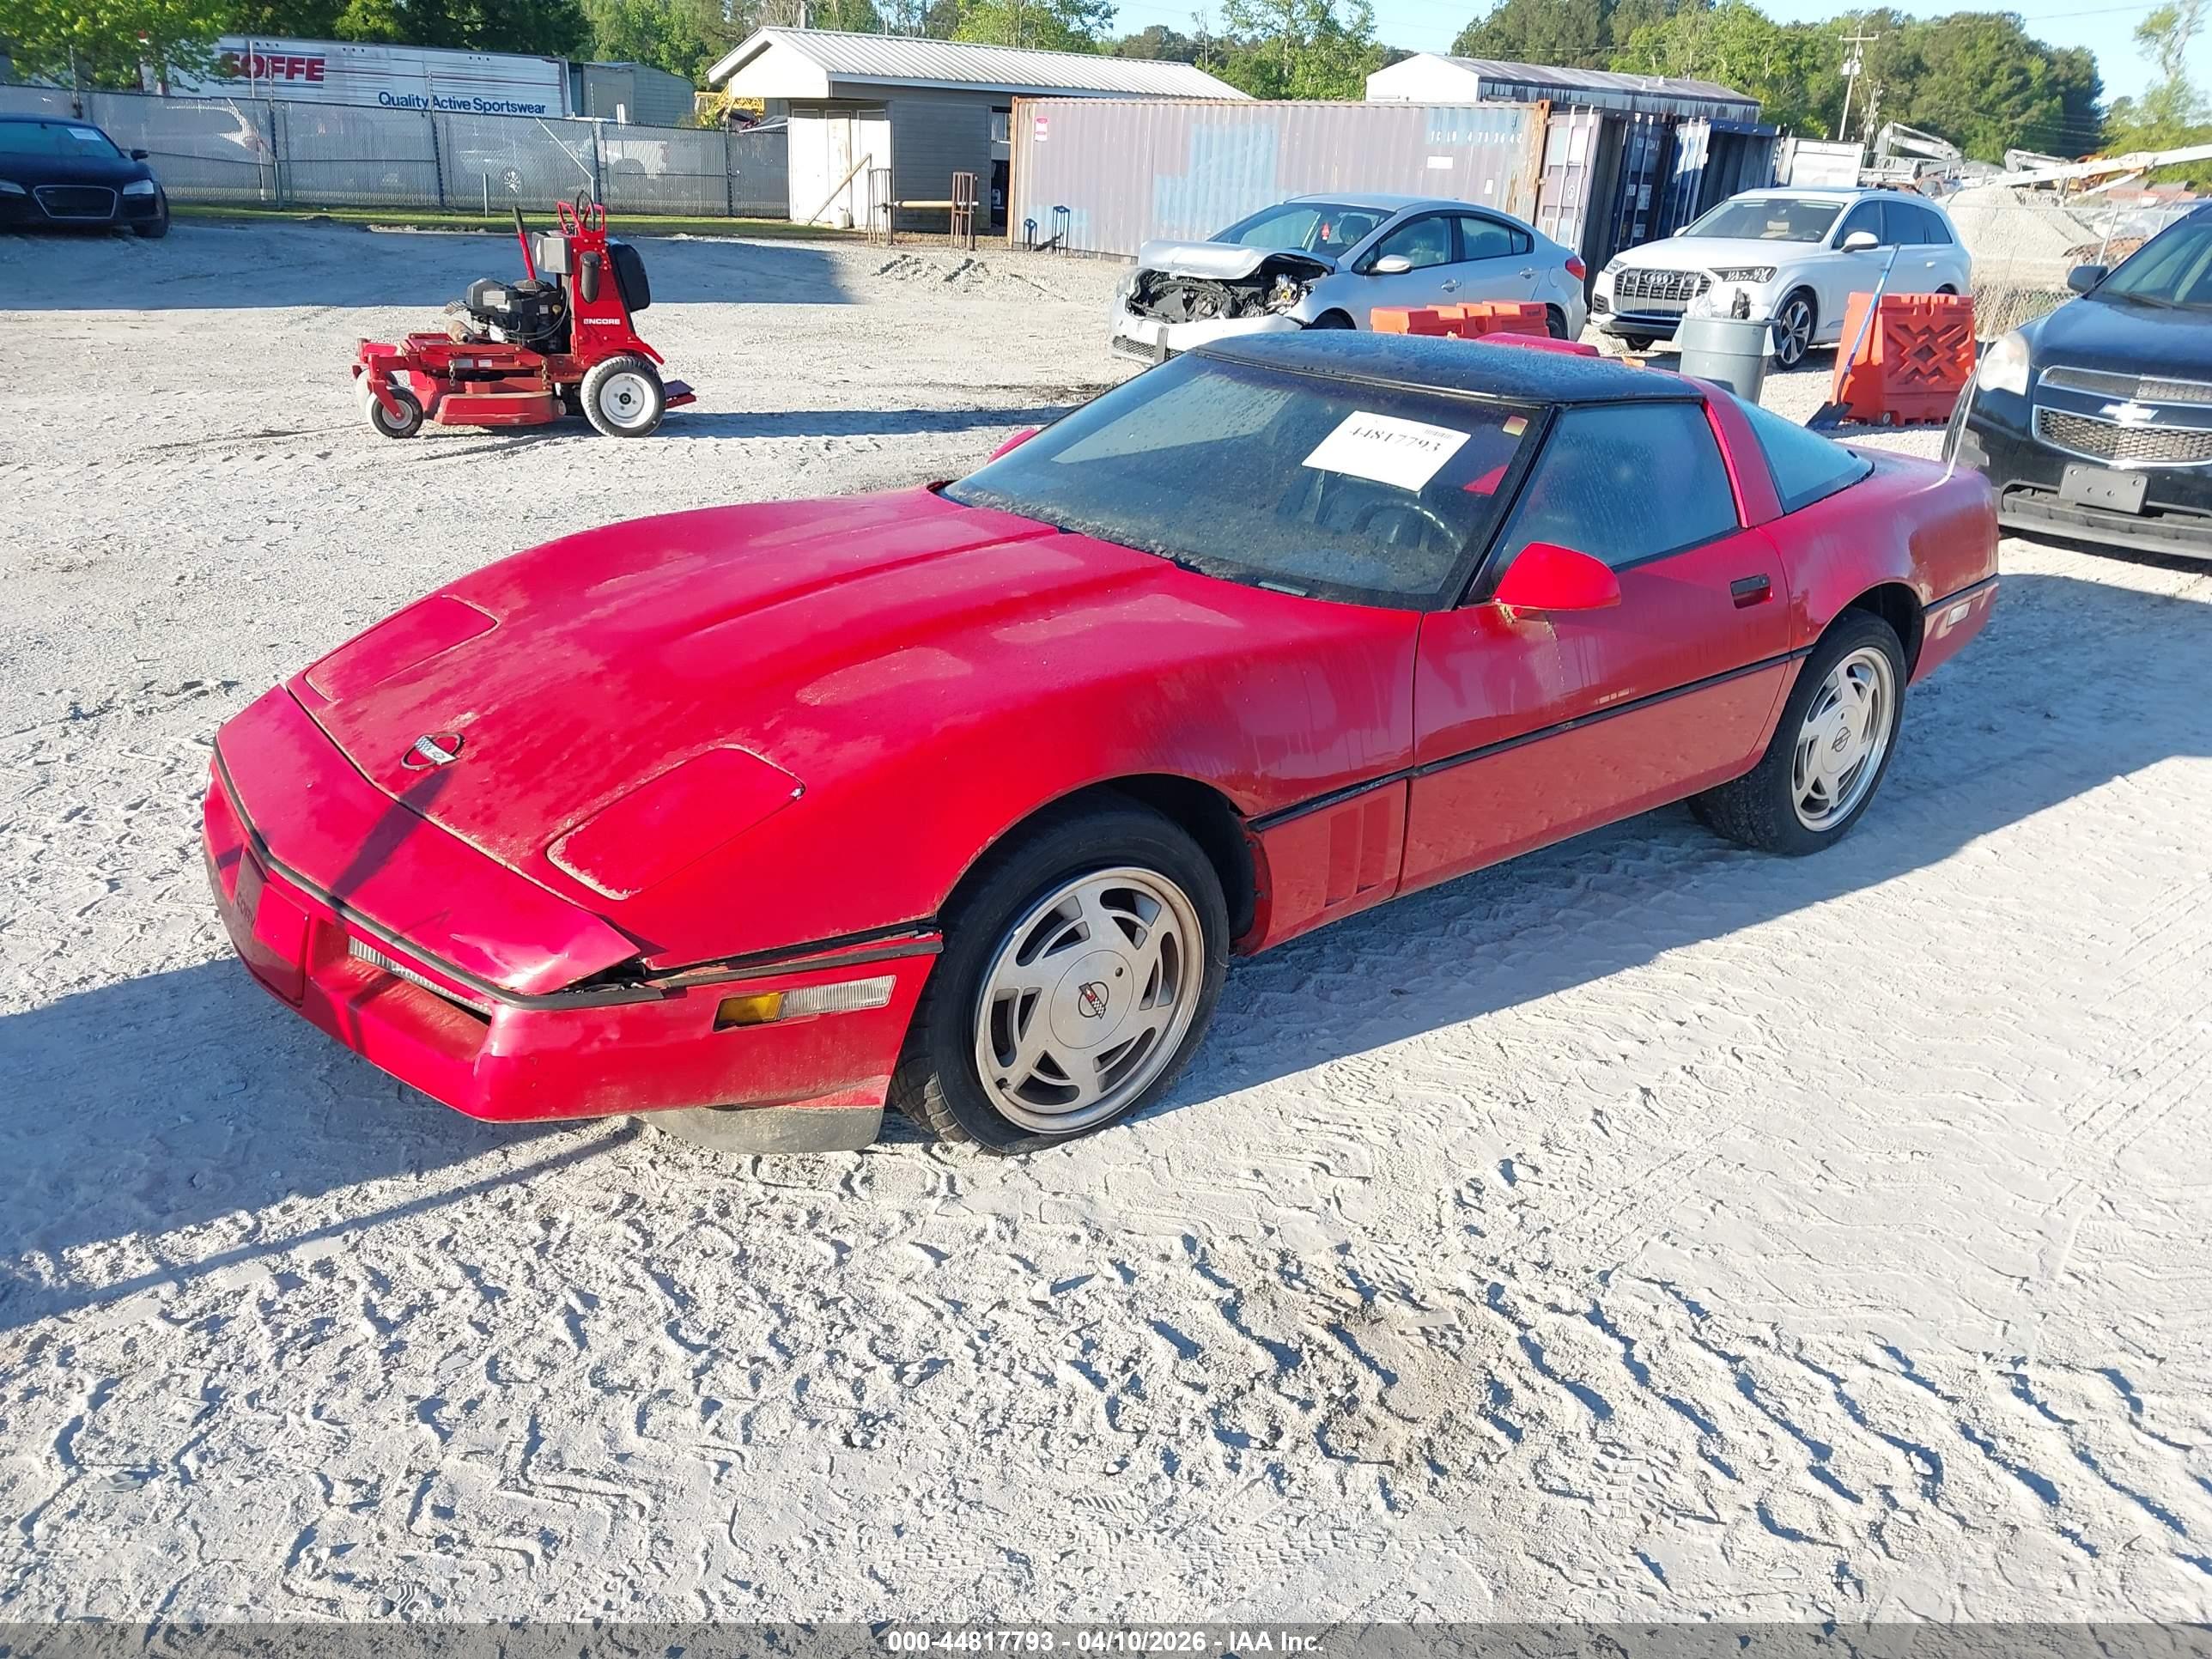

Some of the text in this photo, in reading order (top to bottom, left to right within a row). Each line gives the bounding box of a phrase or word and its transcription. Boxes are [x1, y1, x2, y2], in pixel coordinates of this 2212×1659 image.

[220, 52, 325, 81] SOFFE
[378, 91, 546, 114] Quality Active Sportswear
[1349, 427, 1441, 452] 44817793
